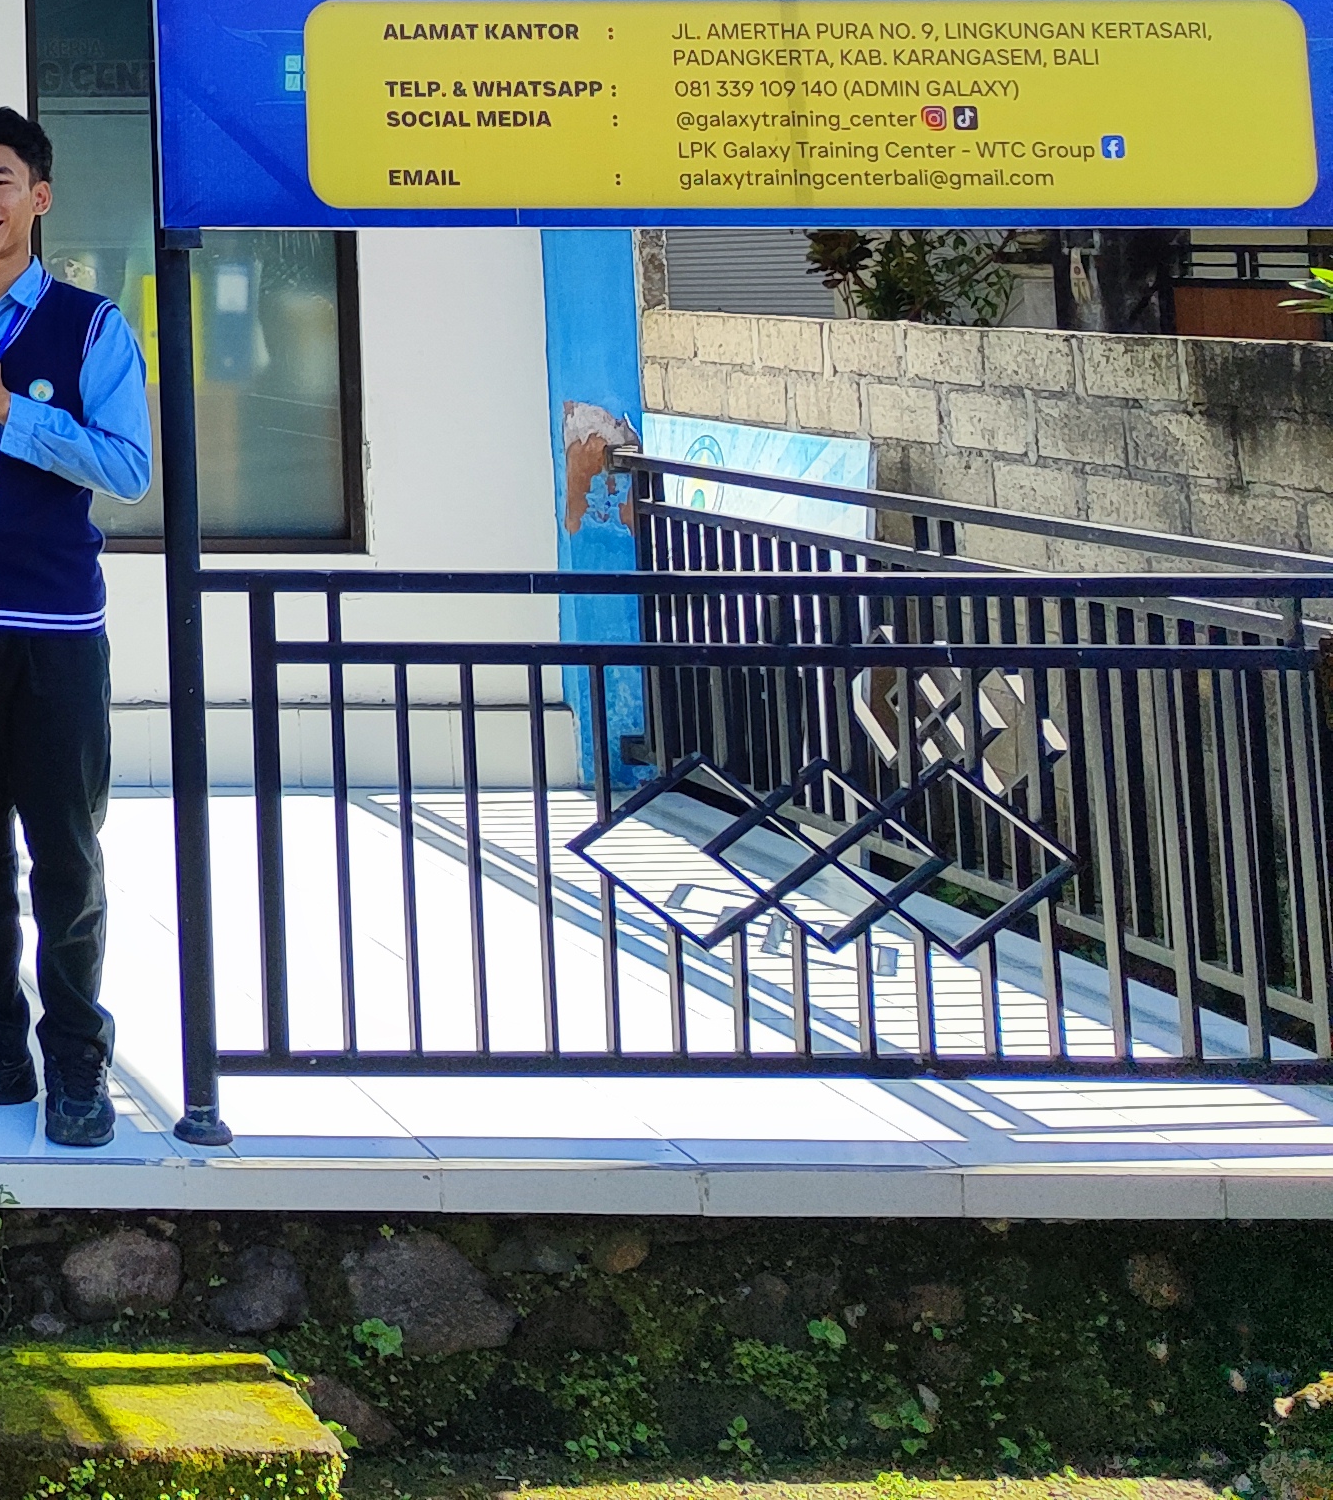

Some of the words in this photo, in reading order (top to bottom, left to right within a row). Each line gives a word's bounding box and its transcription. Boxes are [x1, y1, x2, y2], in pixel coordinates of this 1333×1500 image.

[383, 23, 479, 41] ALAMAT
[484, 23, 581, 41] KANTOR
[671, 22, 702, 41] JL.
[706, 22, 811, 41] AMERTHA
[816, 22, 874, 41] PURA
[879, 22, 916, 41] NO.
[920, 22, 940, 43] 9,
[944, 22, 1085, 41] LINGKUNGAN
[1091, 21, 1213, 43] KERTASARI,
[673, 48, 835, 69] PADANGKERTA,
[840, 48, 889, 67] KAB.
[893, 48, 1049, 69] KARANGASEM,
[1053, 48, 1100, 66] BALI
[385, 80, 447, 98] TELP.
[452, 80, 468, 98] &
[472, 80, 604, 98] WHATSAPP
[674, 79, 711, 98] 081
[716, 79, 755, 98] 339
[759, 79, 797, 98] 109
[801, 79, 838, 98] 140
[843, 79, 920, 101] (ADMIN
[926, 79, 1020, 101] GALAXY)
[386, 110, 471, 128] SOCIAL
[476, 110, 553, 128] MEDIA
[676, 110, 918, 132] @galaxytraining_center
[678, 141, 717, 159] LPK
[723, 141, 792, 163] Galaxy
[796, 141, 880, 163] Training
[885, 141, 956, 159] Center
[975, 141, 1026, 159] WTC
[1031, 141, 1096, 163] Group
[388, 169, 462, 186] EMAIL
[679, 168, 1055, 190] galaxytrainingcenterbali@gmail.com
